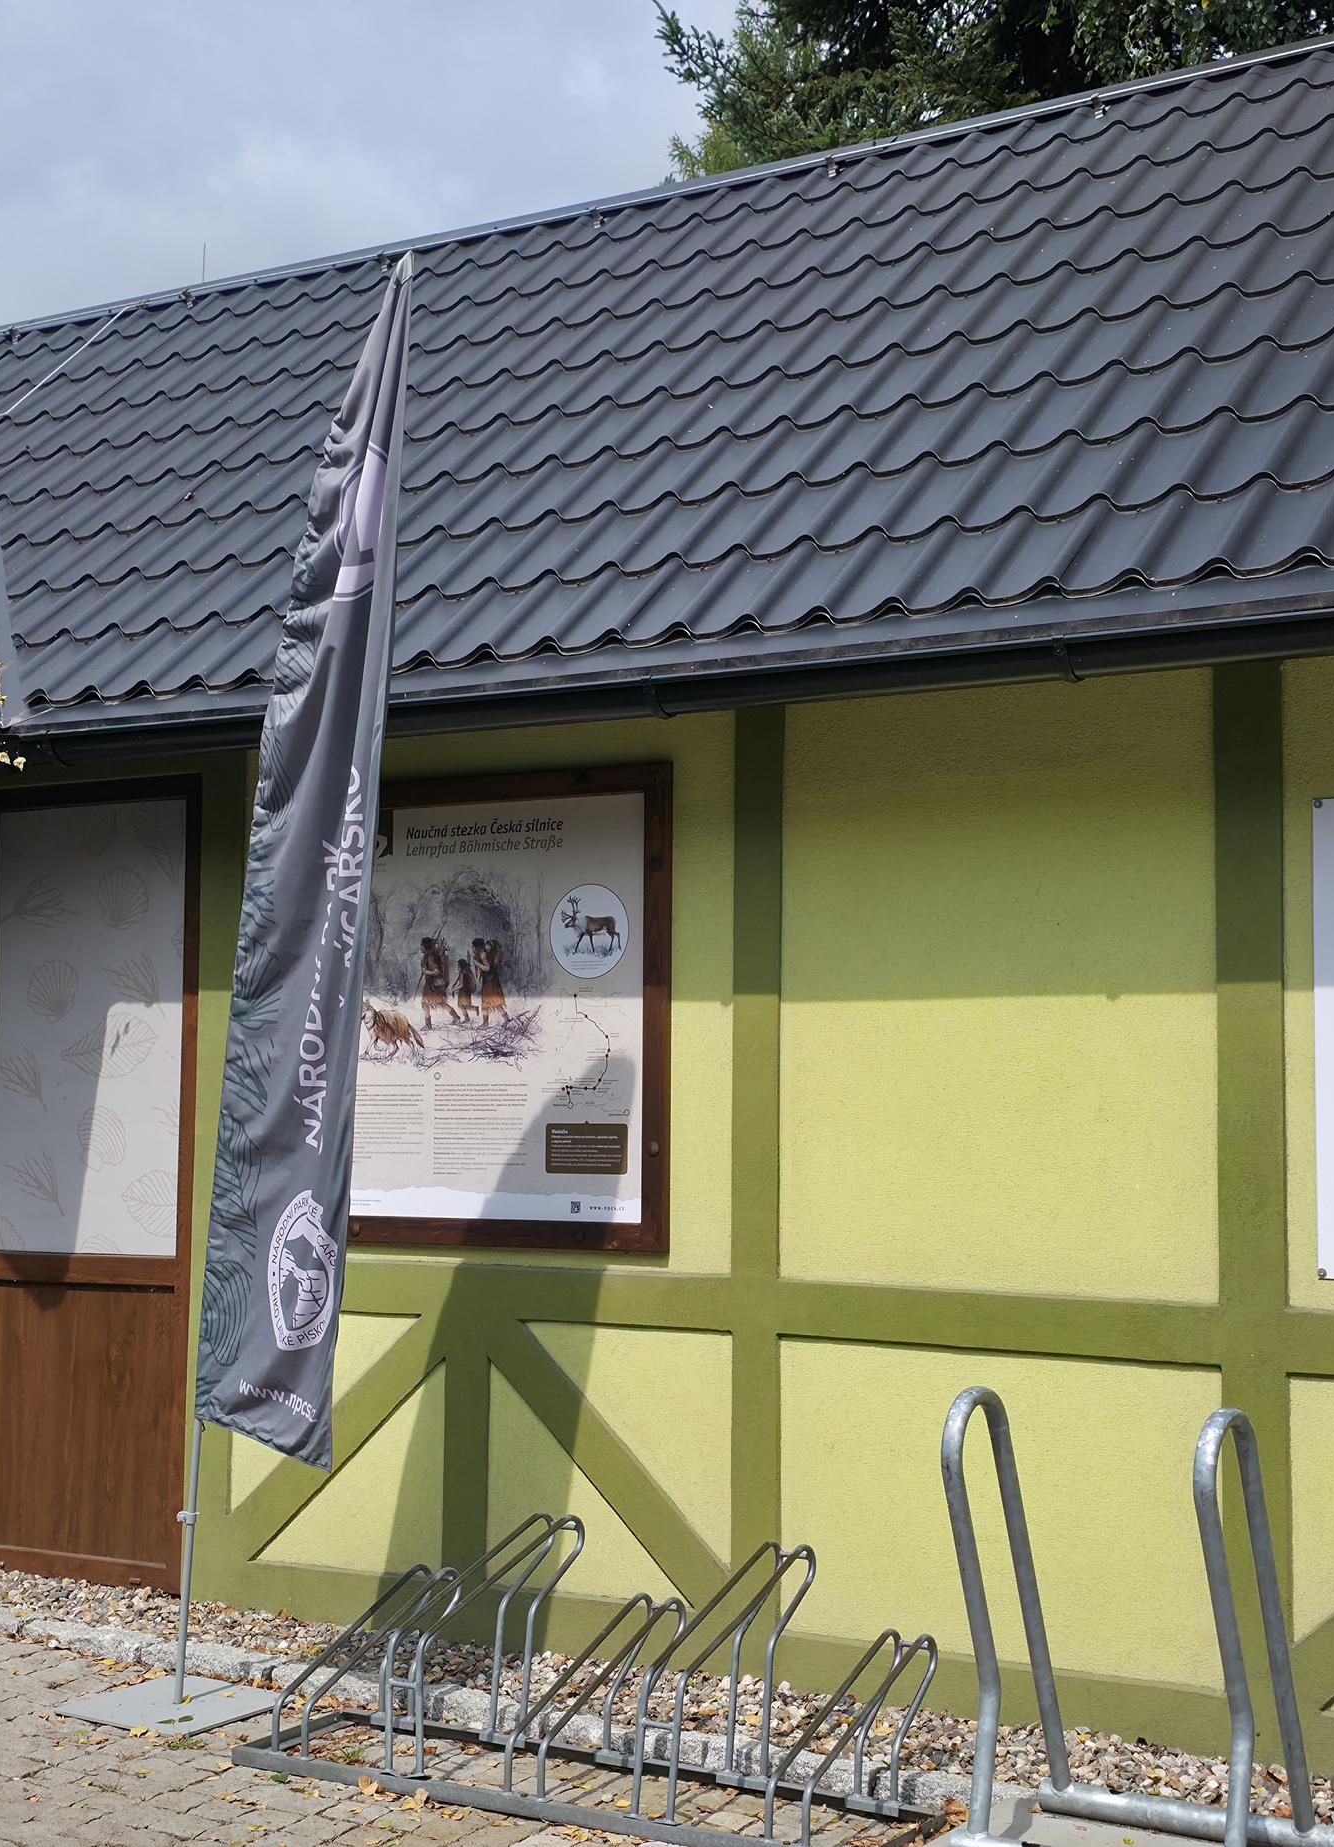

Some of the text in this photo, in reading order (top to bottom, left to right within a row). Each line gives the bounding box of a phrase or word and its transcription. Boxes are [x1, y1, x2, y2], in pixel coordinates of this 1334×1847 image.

[406, 817, 564, 840] Naučná stezka Česká silnice
[406, 835, 564, 858] Lehrpfad Böhmische Straße
